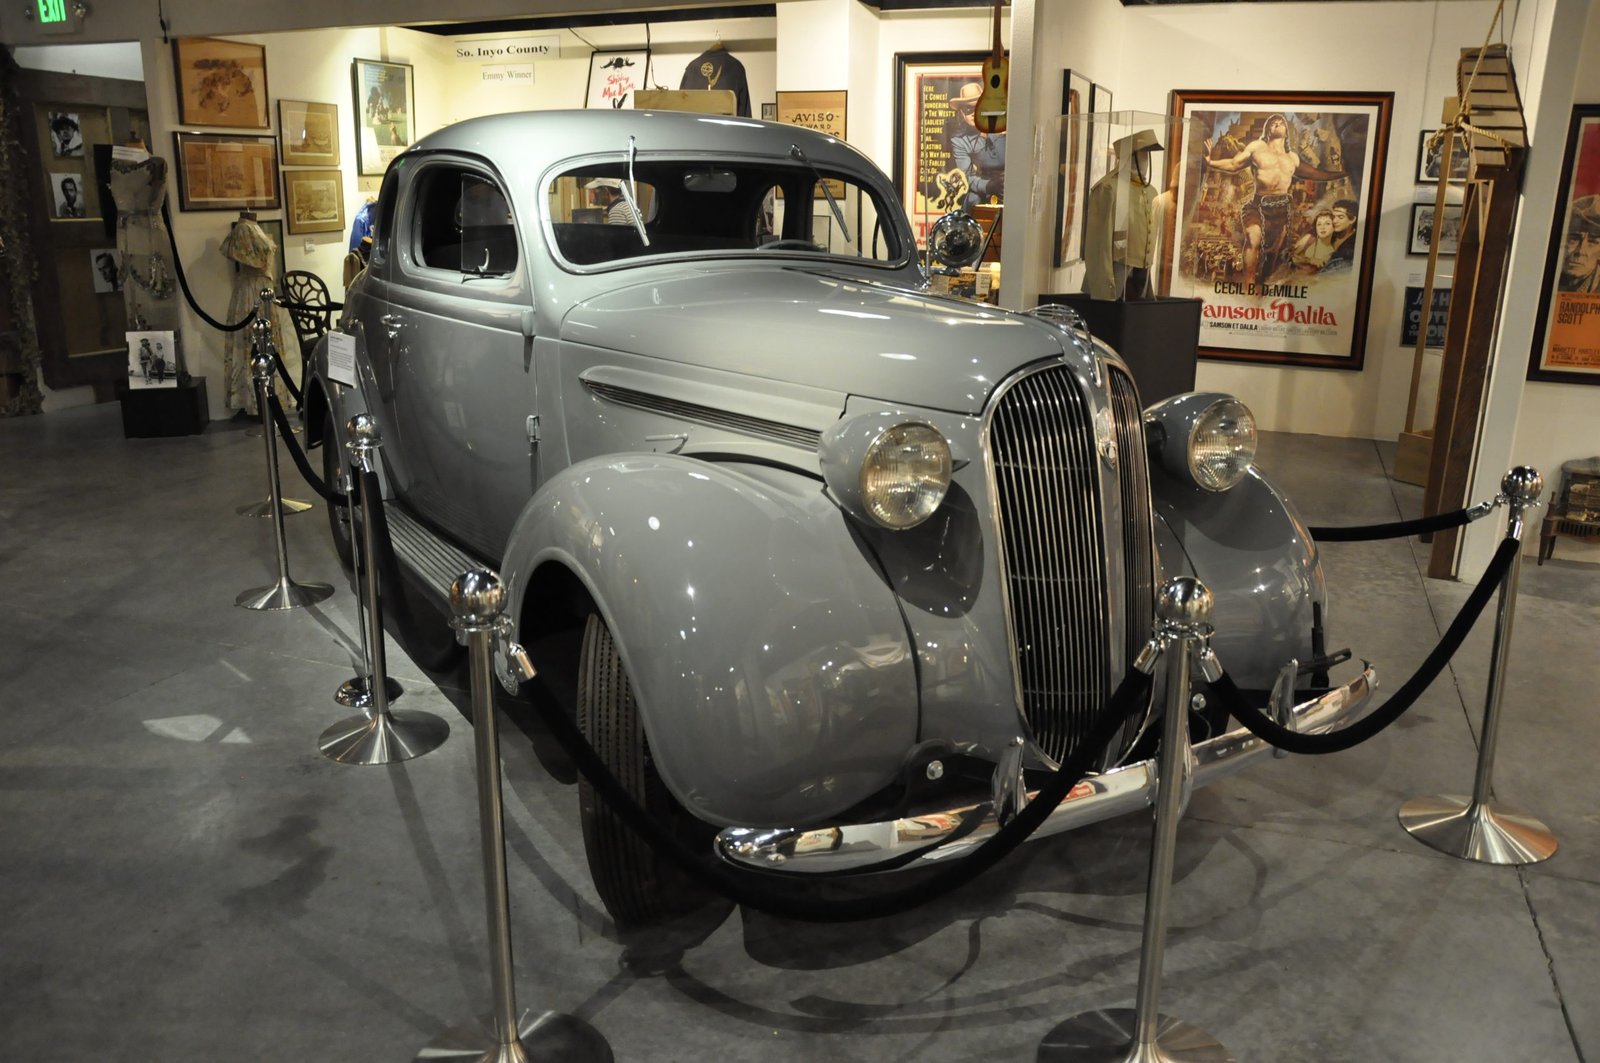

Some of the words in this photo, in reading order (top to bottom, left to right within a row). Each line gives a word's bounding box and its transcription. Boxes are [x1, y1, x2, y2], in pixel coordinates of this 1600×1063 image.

[38, 0, 67, 22] EXIT
[456, 48, 474, 58] So.
[477, 47, 503, 58] Inyo
[506, 45, 550, 54] County
[482, 71, 505, 81] Emmy
[506, 70, 532, 79] Winner
[792, 113, 834, 123] AVISO
[1214, 280, 1245, 295] CECIL
[1247, 282, 1259, 296] B.
[1203, 304, 1267, 321] amson
[1270, 299, 1338, 326] Dalila
[1557, 312, 1584, 324] SCOTT
[1209, 321, 1233, 330] SAMSON
[1240, 322, 1259, 331] DALILA
